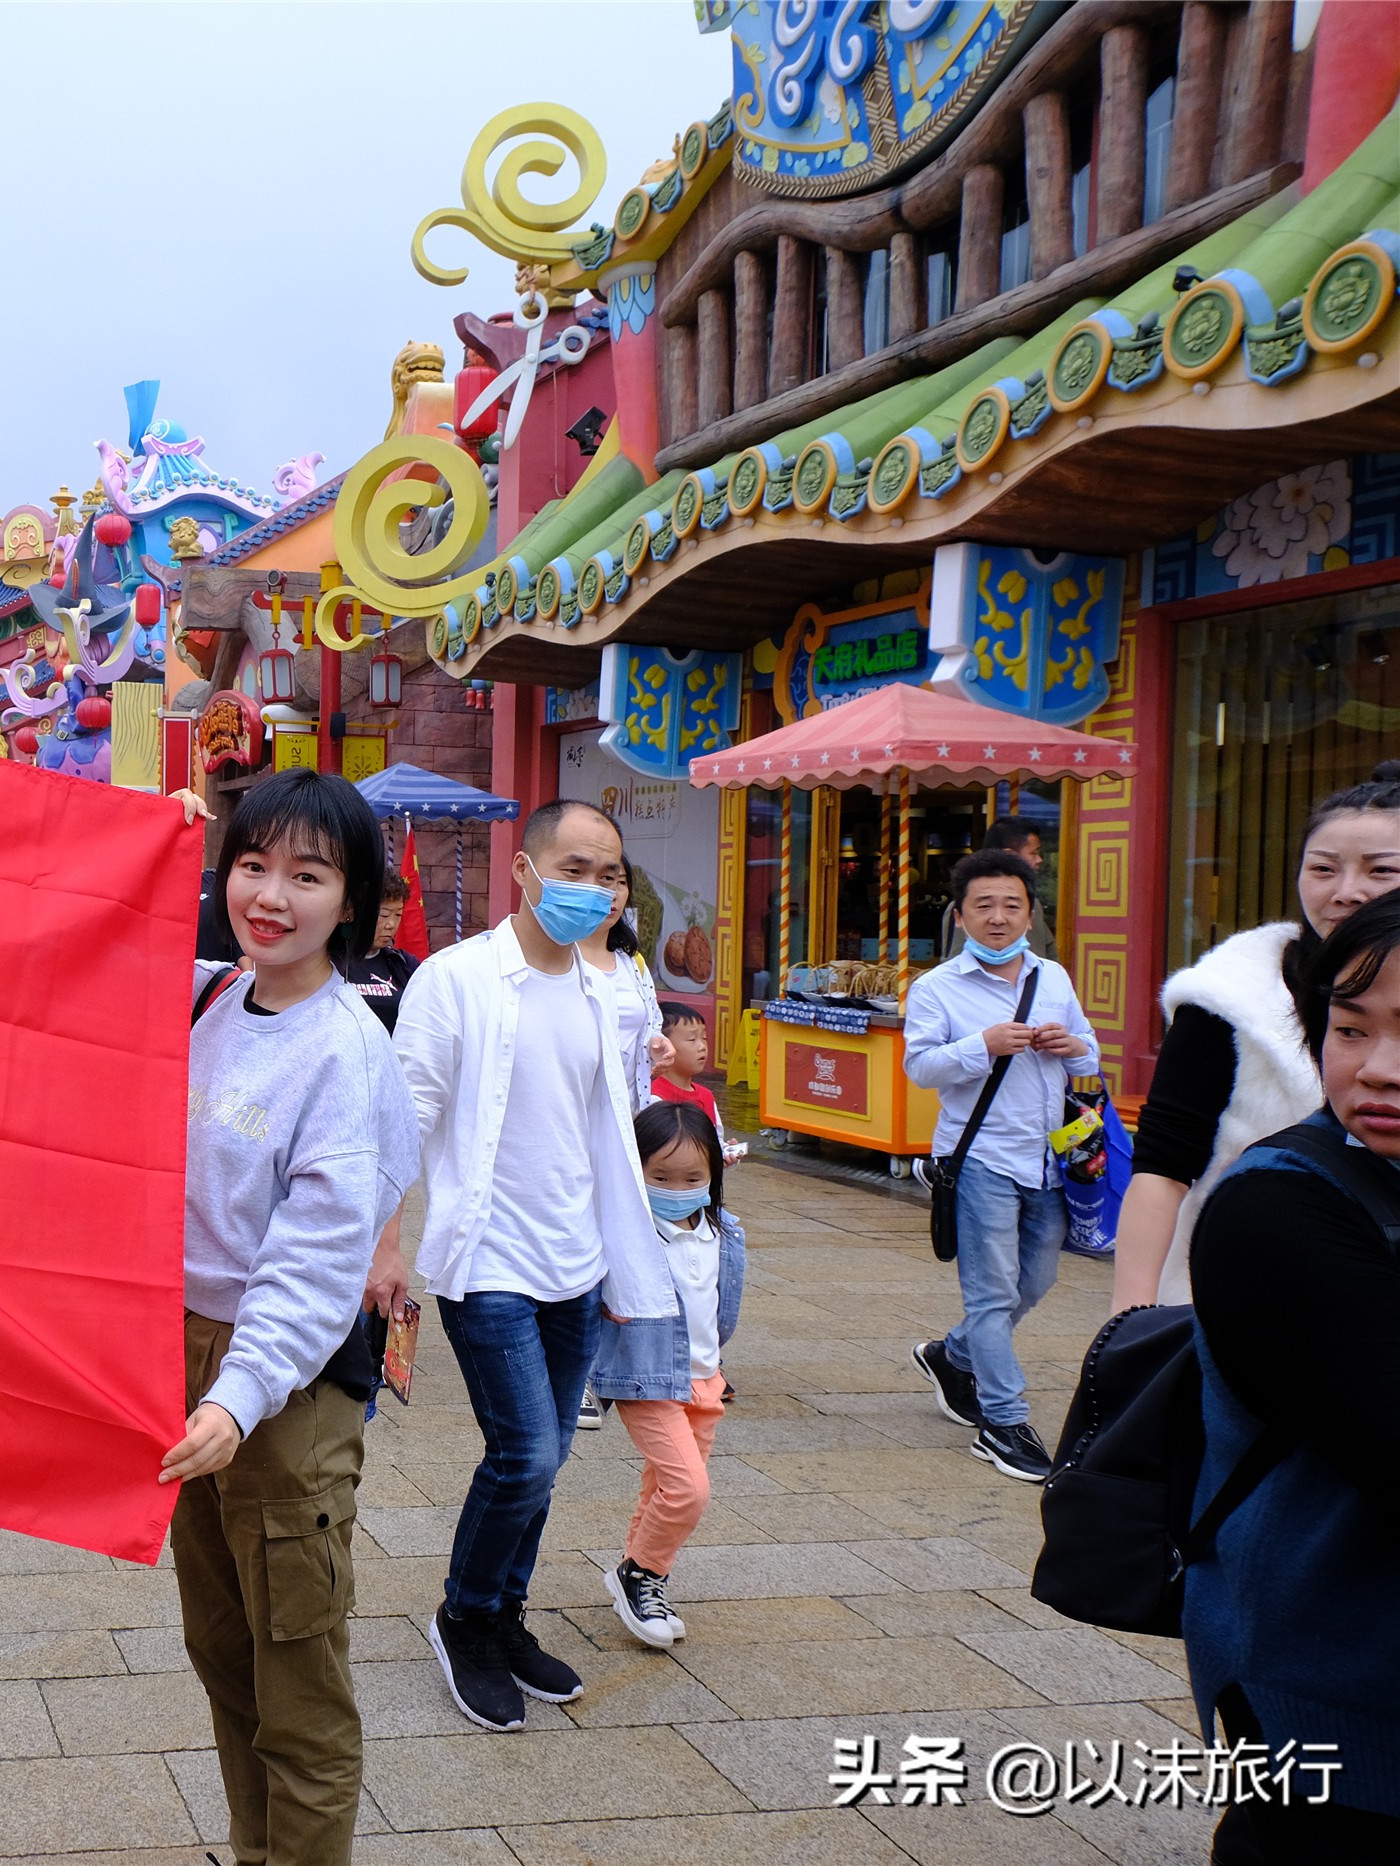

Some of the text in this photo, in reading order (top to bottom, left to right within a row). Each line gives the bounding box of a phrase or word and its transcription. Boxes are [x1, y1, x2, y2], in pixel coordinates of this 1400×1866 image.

[814, 630, 918, 684] 天府礼品店
[352, 983, 393, 997] UMA
[201, 1091, 270, 1143] Hills
